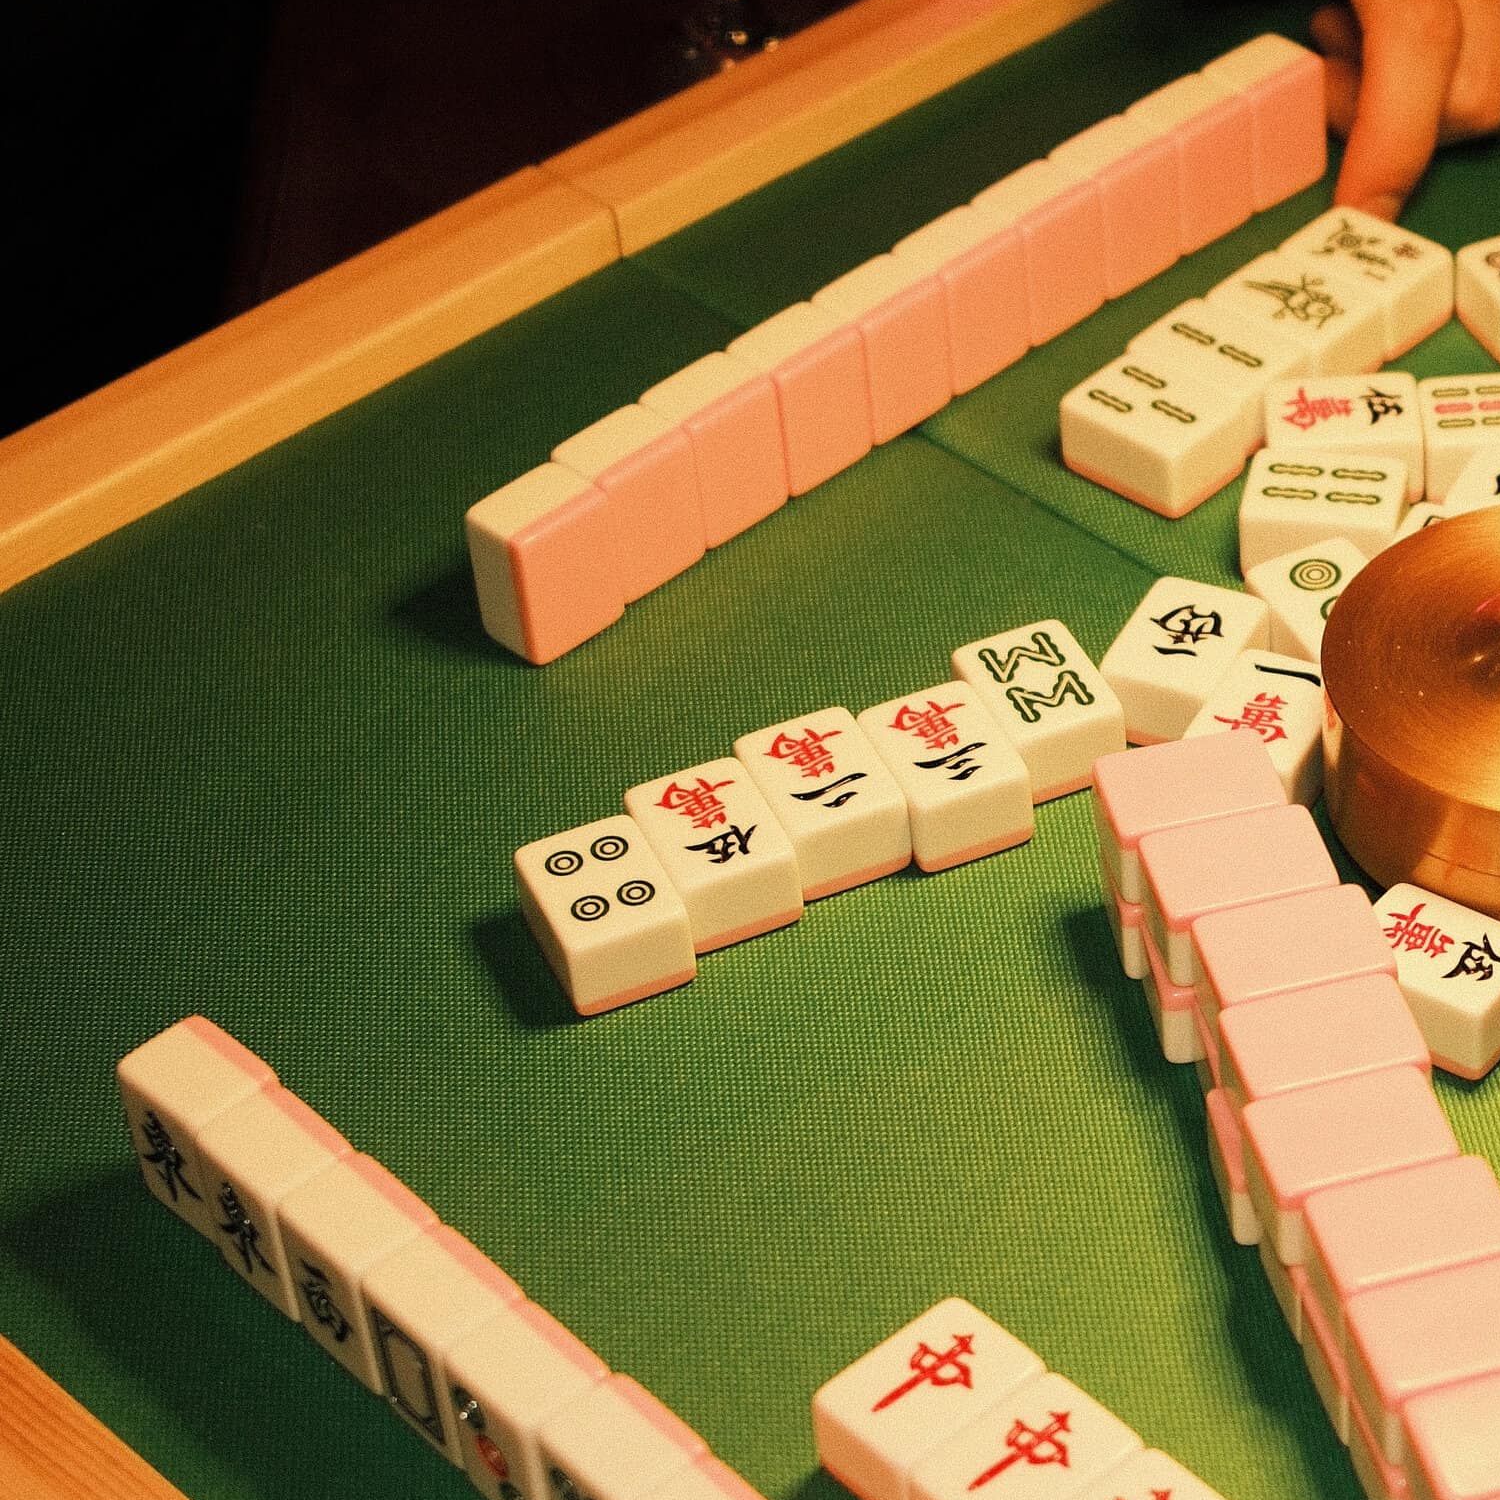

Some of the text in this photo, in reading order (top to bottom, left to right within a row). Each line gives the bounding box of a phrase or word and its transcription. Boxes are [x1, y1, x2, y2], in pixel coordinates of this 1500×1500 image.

[1284, 389, 1403, 430] 伍萬
[1151, 605, 1222, 656] 西
[887, 700, 987, 781] 三萬
[1215, 664, 1321, 743] 一萬
[762, 727, 868, 808] 二萬
[653, 777, 757, 864] 伍萬
[142, 1110, 202, 1202] 東
[218, 1182, 277, 1277] 東
[871, 1333, 975, 1413] 中
[969, 1413, 1070, 1490] 中
